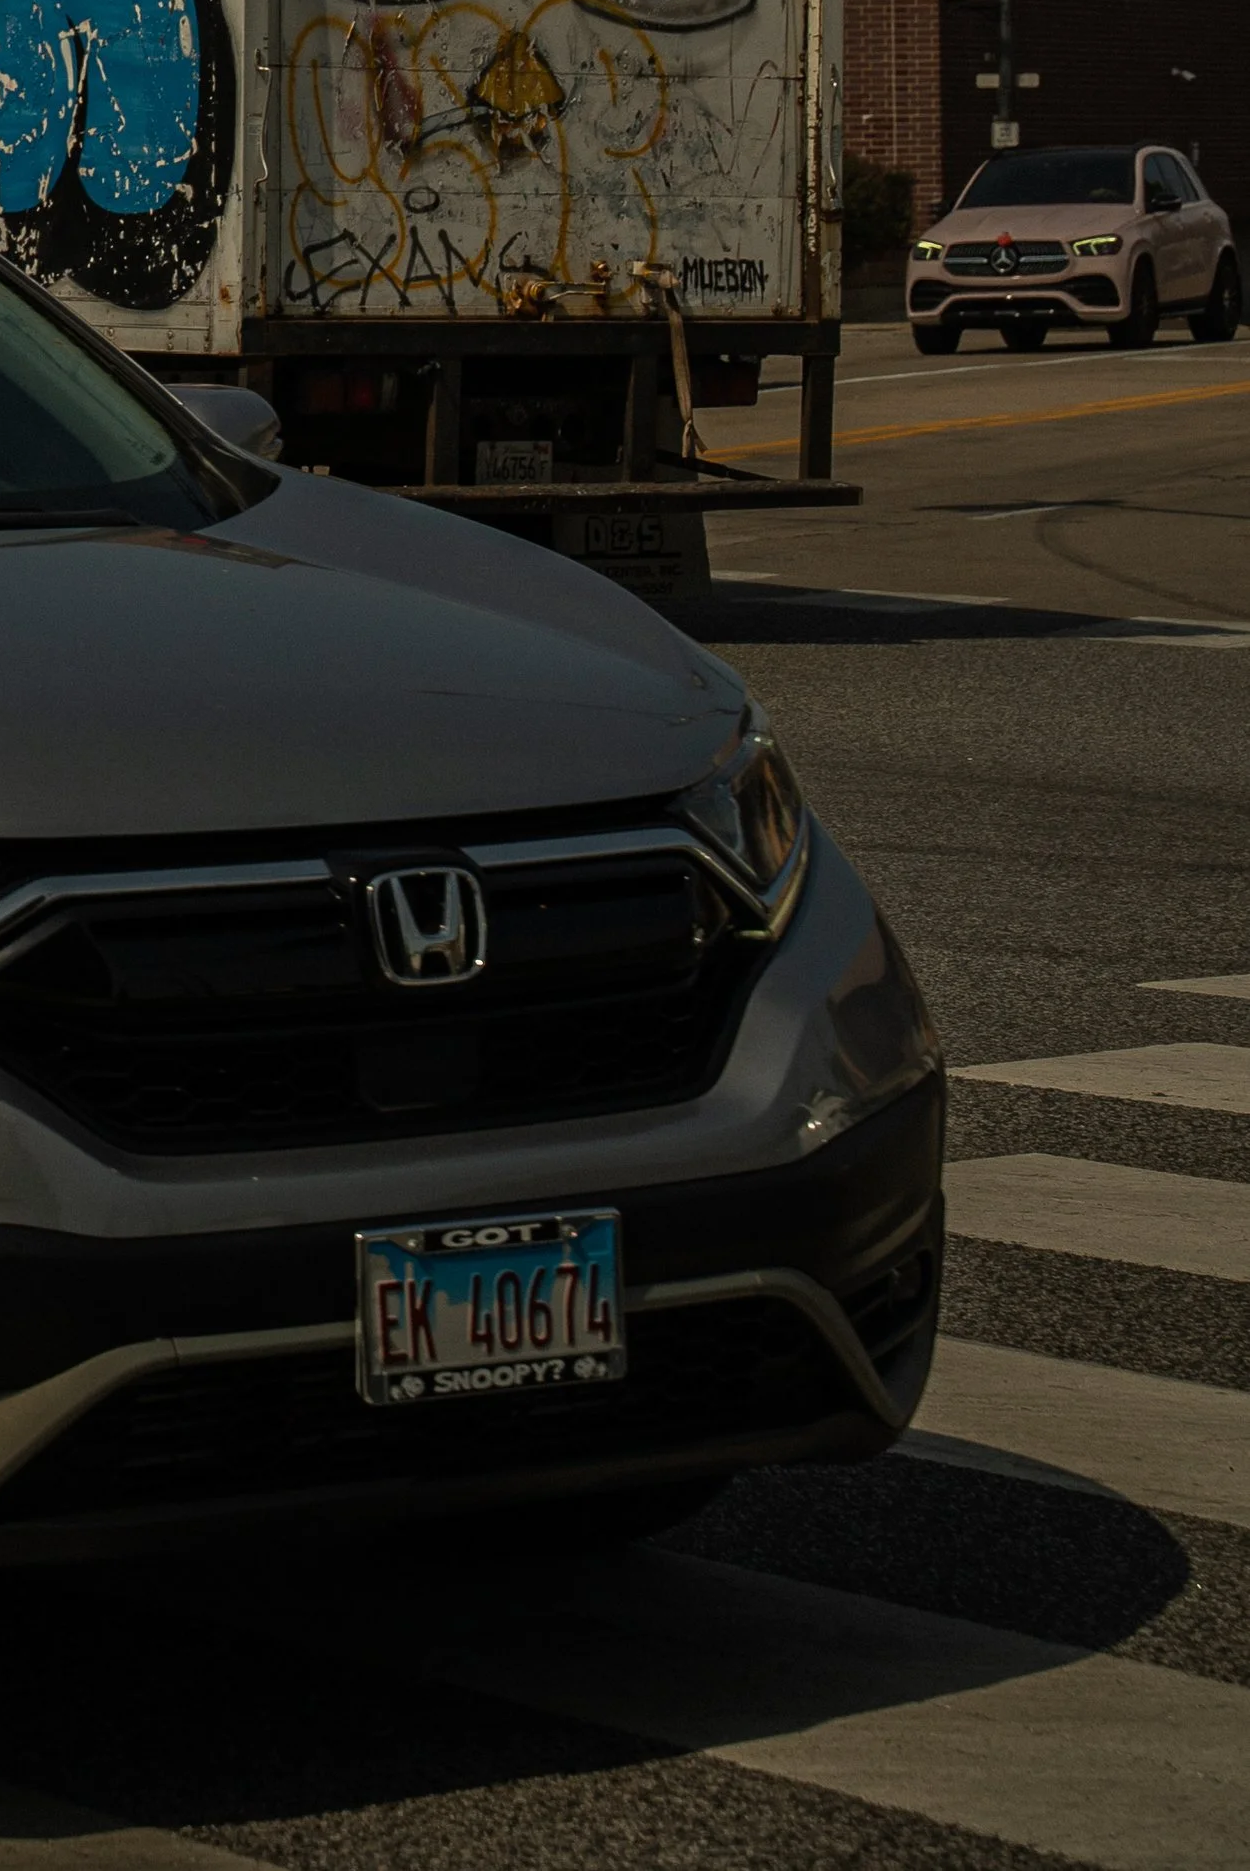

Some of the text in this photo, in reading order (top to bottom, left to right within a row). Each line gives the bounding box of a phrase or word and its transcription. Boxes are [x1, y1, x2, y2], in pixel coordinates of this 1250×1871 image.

[440, 1222, 543, 1248] GOT
[376, 1262, 611, 1365] EK 40674
[432, 1358, 567, 1393] SNOOPY?
